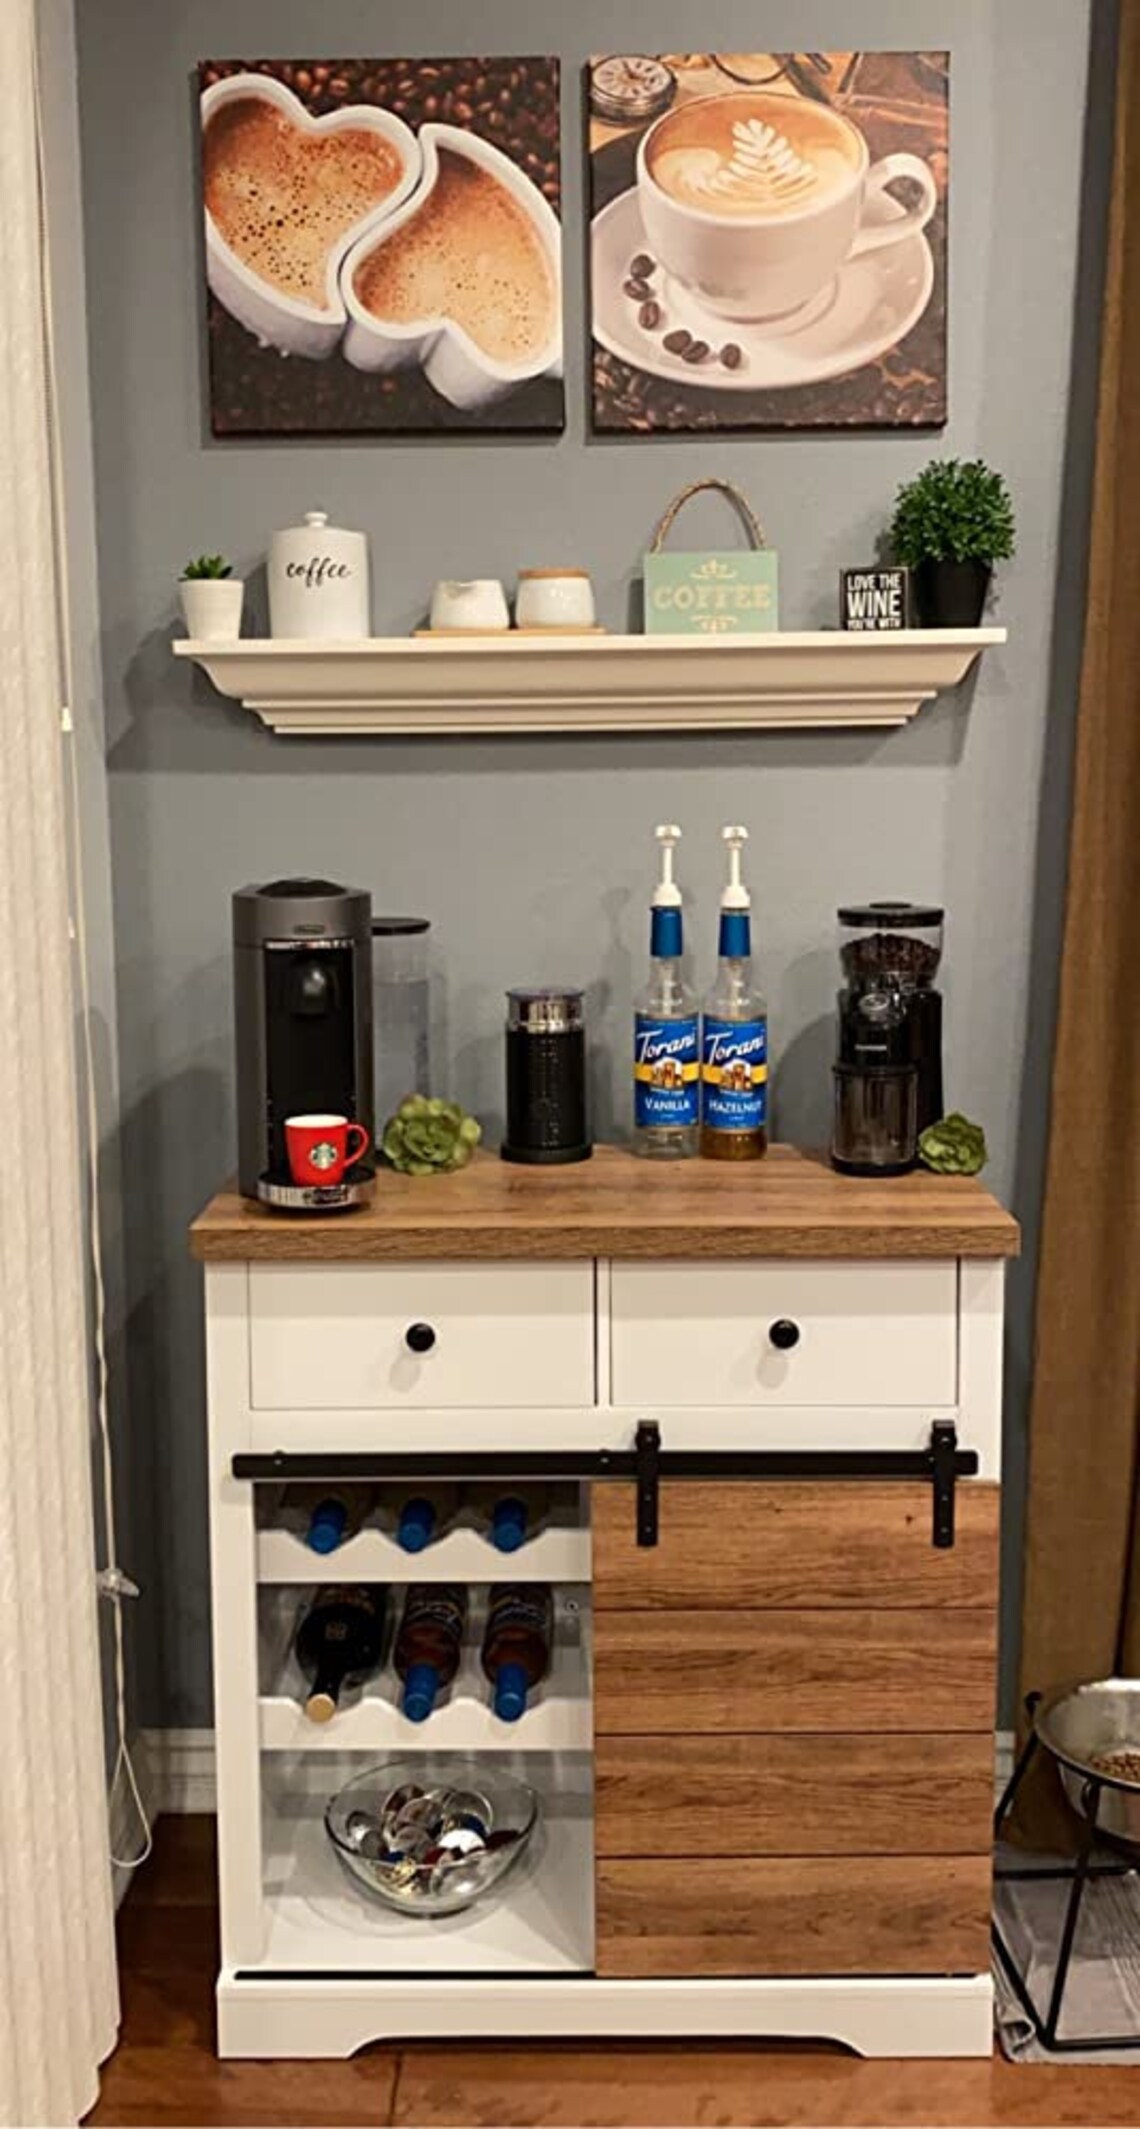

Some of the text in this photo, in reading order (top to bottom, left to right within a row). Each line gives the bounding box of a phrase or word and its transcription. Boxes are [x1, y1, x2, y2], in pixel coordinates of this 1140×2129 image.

[286, 557, 351, 588] coffee
[847, 573, 901, 590] LOVE THE
[654, 584, 770, 610] COFFEE
[847, 590, 901, 618] WINE
[644, 1097, 691, 1111] VANILLA
[709, 1099, 762, 1114] HAZELNUT
